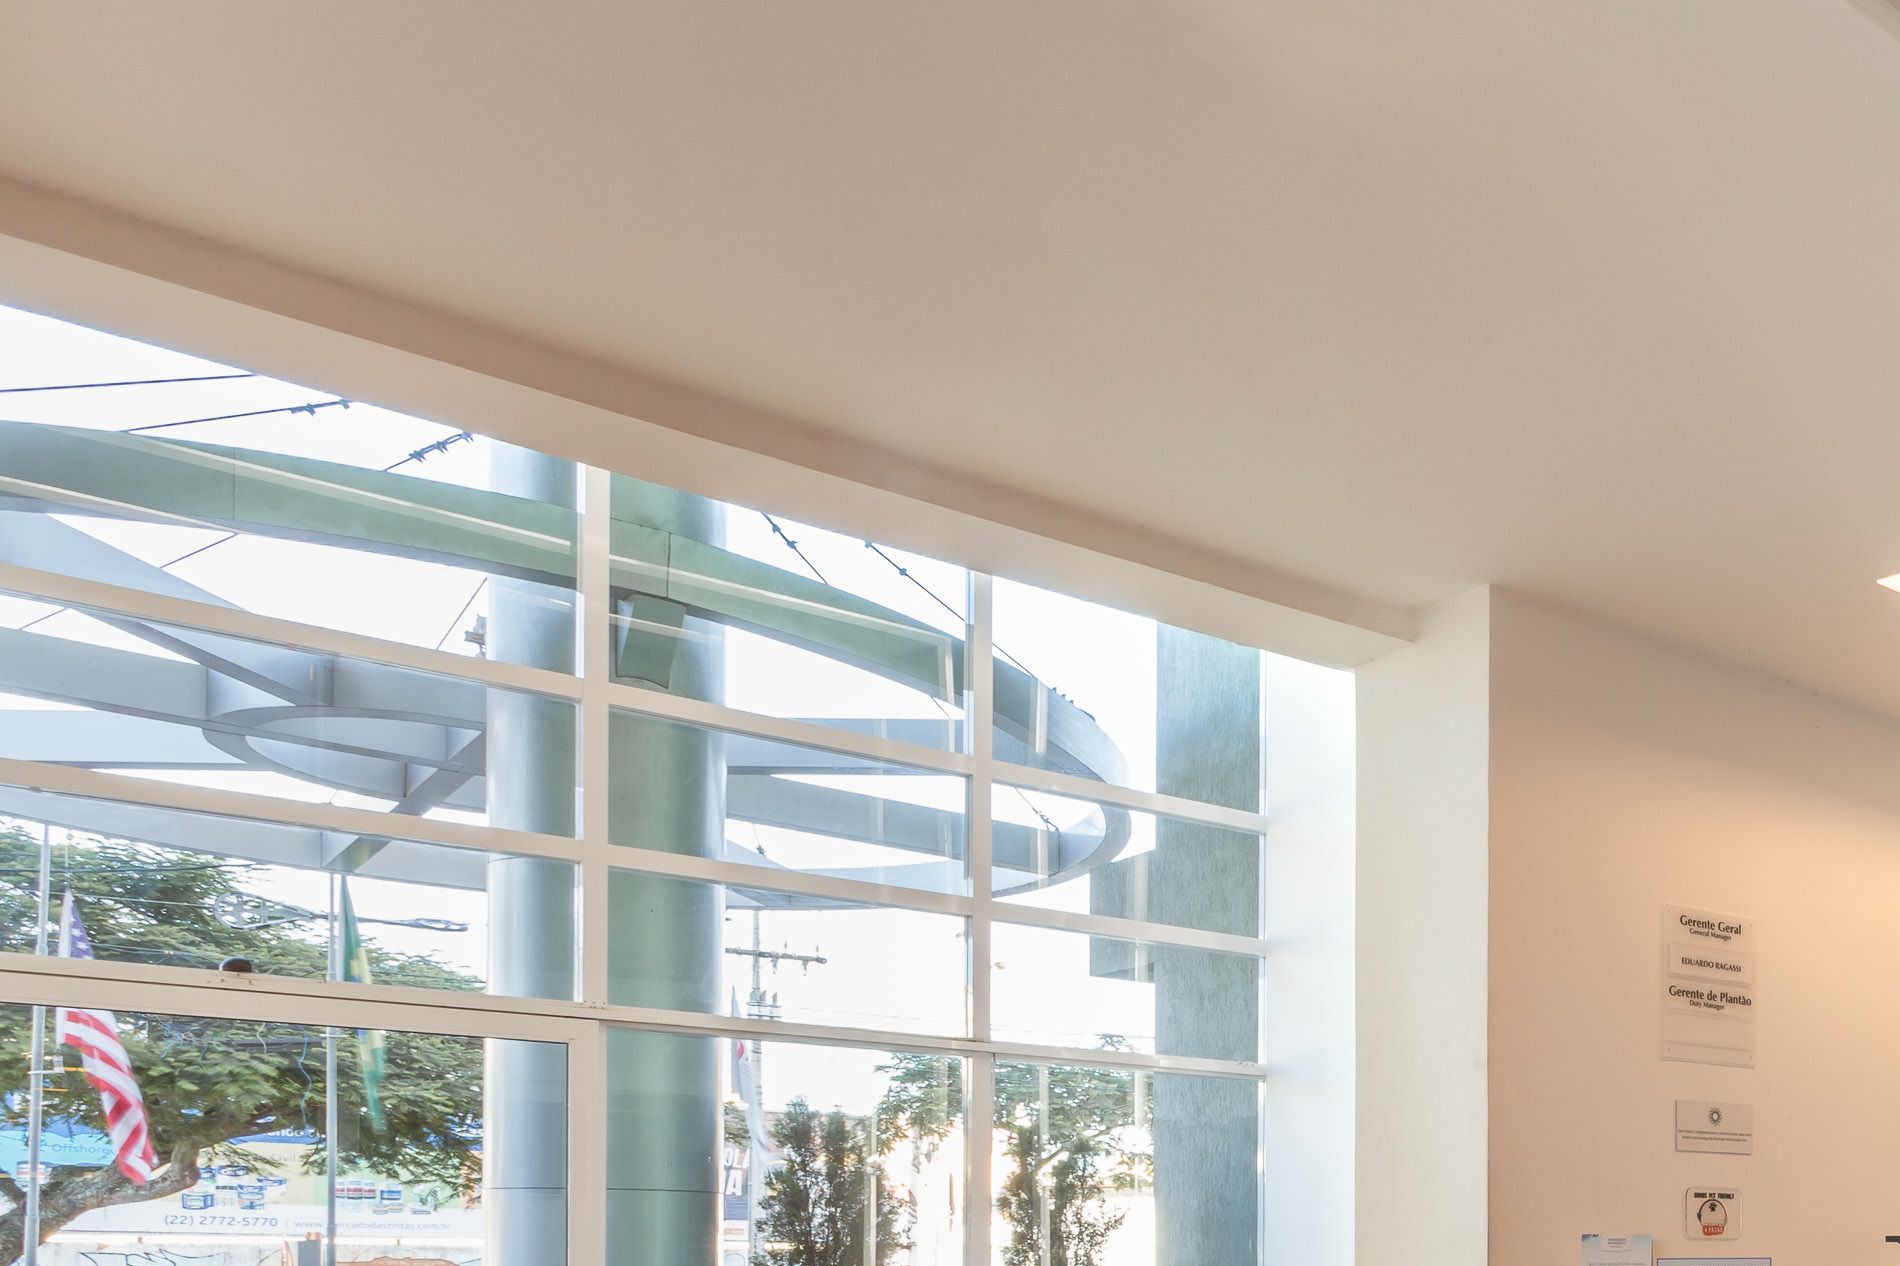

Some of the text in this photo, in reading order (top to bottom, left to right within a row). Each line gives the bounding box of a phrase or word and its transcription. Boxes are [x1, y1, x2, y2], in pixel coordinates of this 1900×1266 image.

[1680, 914, 1742, 935] Gerente Geral
[1689, 928, 1732, 942] General Manager
[1681, 956, 1742, 973] EDUARDO RAGASSI
[1668, 984, 1752, 1007] Gerente de Plantão
[1703, 1001, 1725, 1011] Manager
[52, 1142, 110, 1155] Offshore
[164, 1215, 279, 1228] (22) 2772-5770
